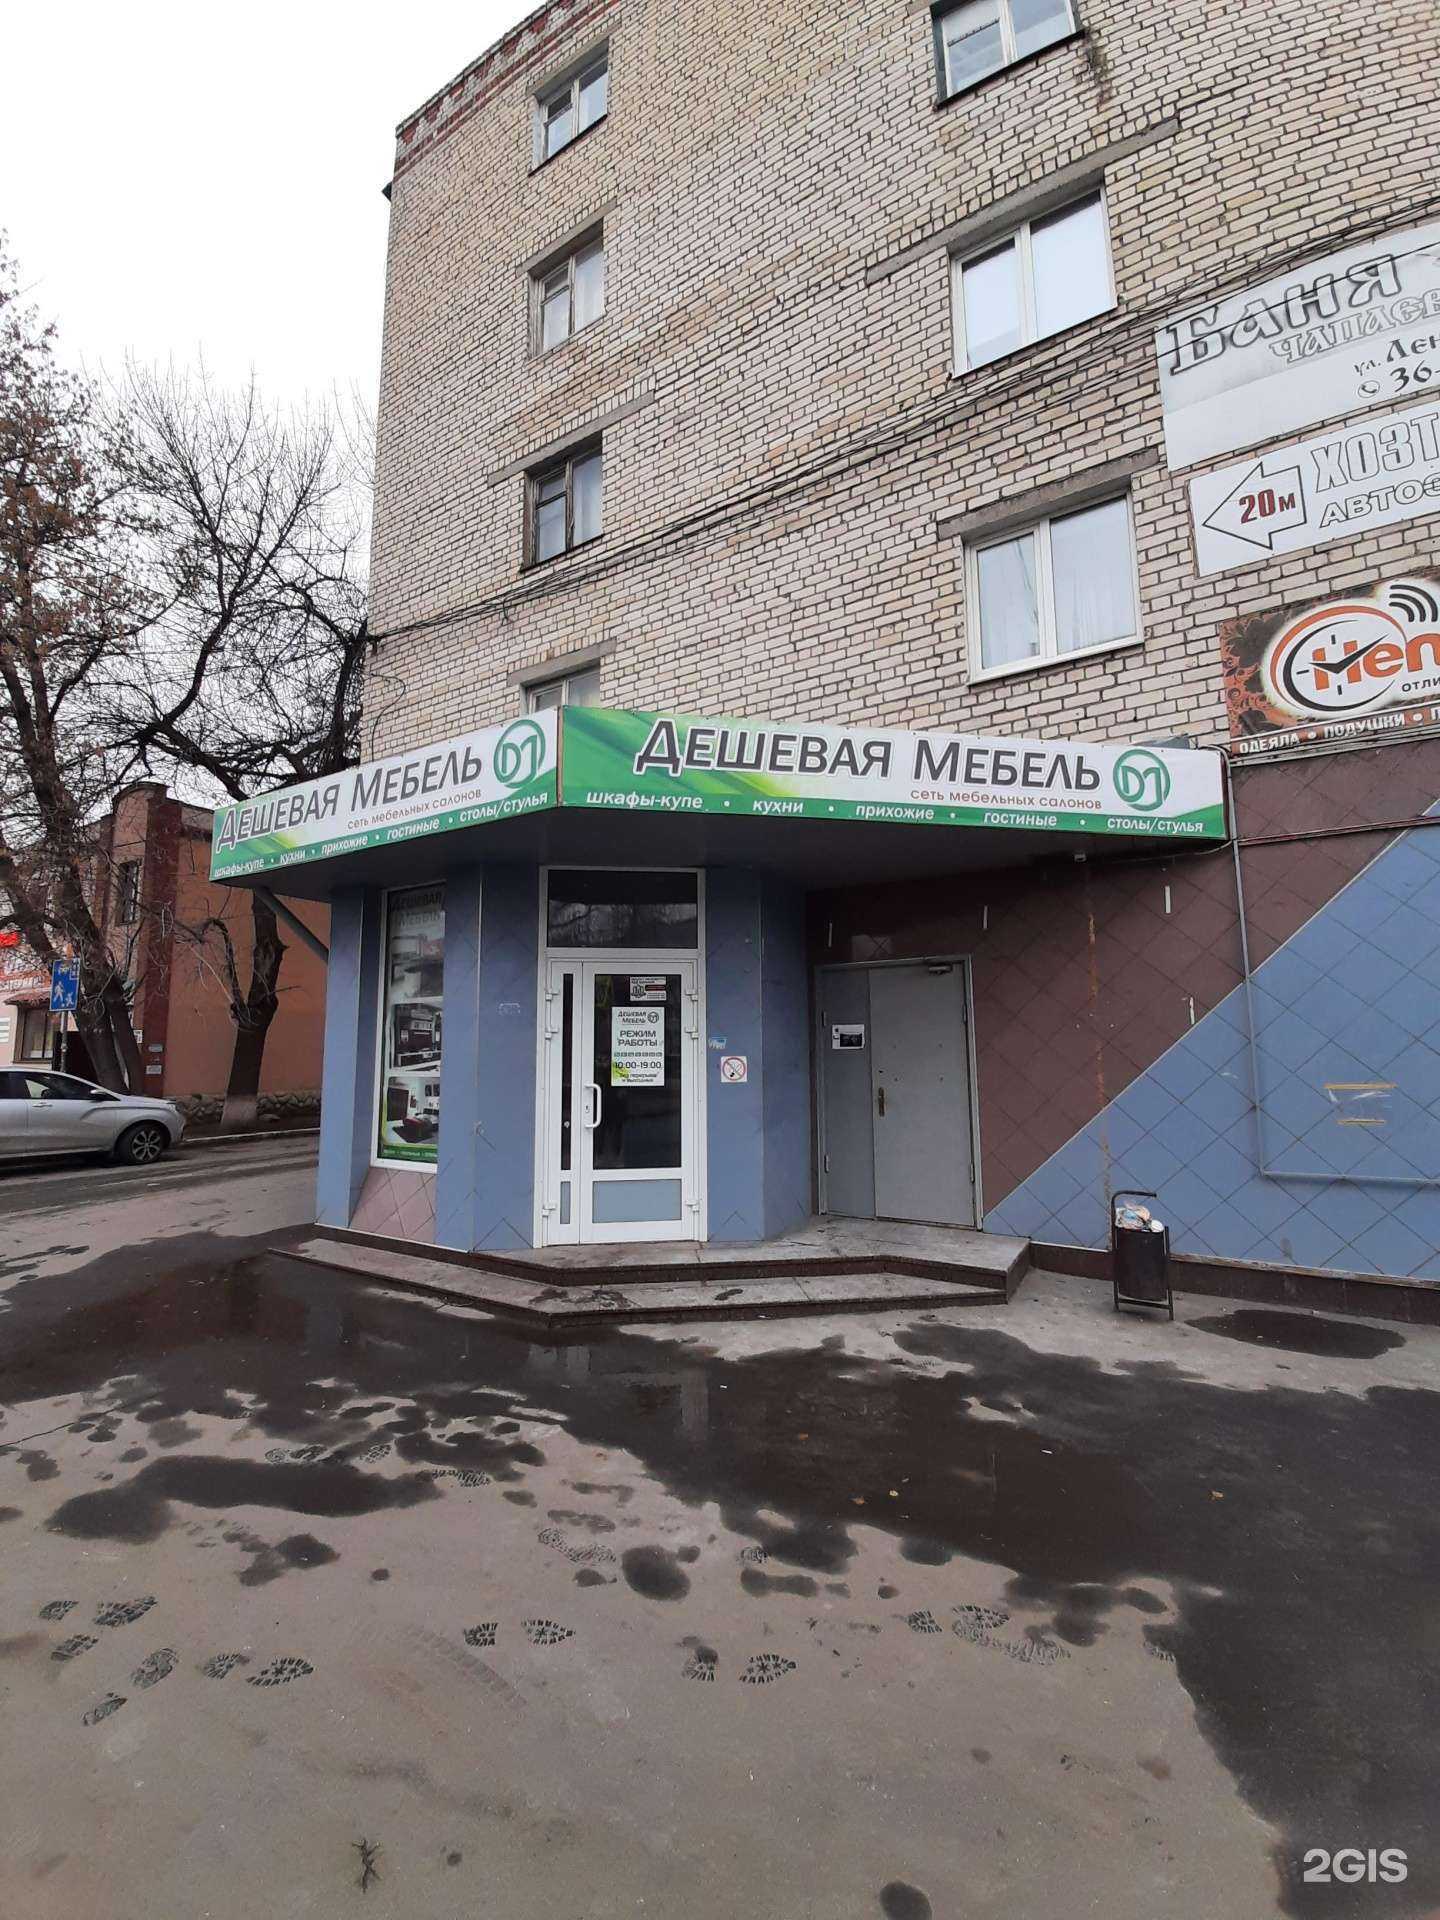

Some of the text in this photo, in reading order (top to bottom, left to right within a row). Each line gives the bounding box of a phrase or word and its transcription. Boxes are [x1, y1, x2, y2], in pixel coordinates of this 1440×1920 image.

[1167, 254, 1401, 376] БАНЯ
[1311, 412, 1439, 493] ХОЗТ
[635, 718, 893, 778] ДЕШЕВАЯ
[912, 738, 1101, 791] МЕБЕЛЬ
[1239, 732, 1300, 754] ОДЕЯЛА
[1324, 712, 1406, 739] ПОДУШКИ
[217, 783, 341, 851] ДЕШЕВАЯ
[351, 746, 482, 812] МЕБЕЛЬ
[280, 850, 306, 866] кухни
[321, 836, 369, 856] прихожие
[387, 817, 440, 841] гостиные
[459, 792, 548, 823] столы/стулья
[347, 789, 482, 830] сеть мебельных салонов
[586, 791, 1203, 833] шкафы-купе кухни прихожие гостиные столы/стулья
[911, 789, 1102, 810] сеть мебельных салонов
